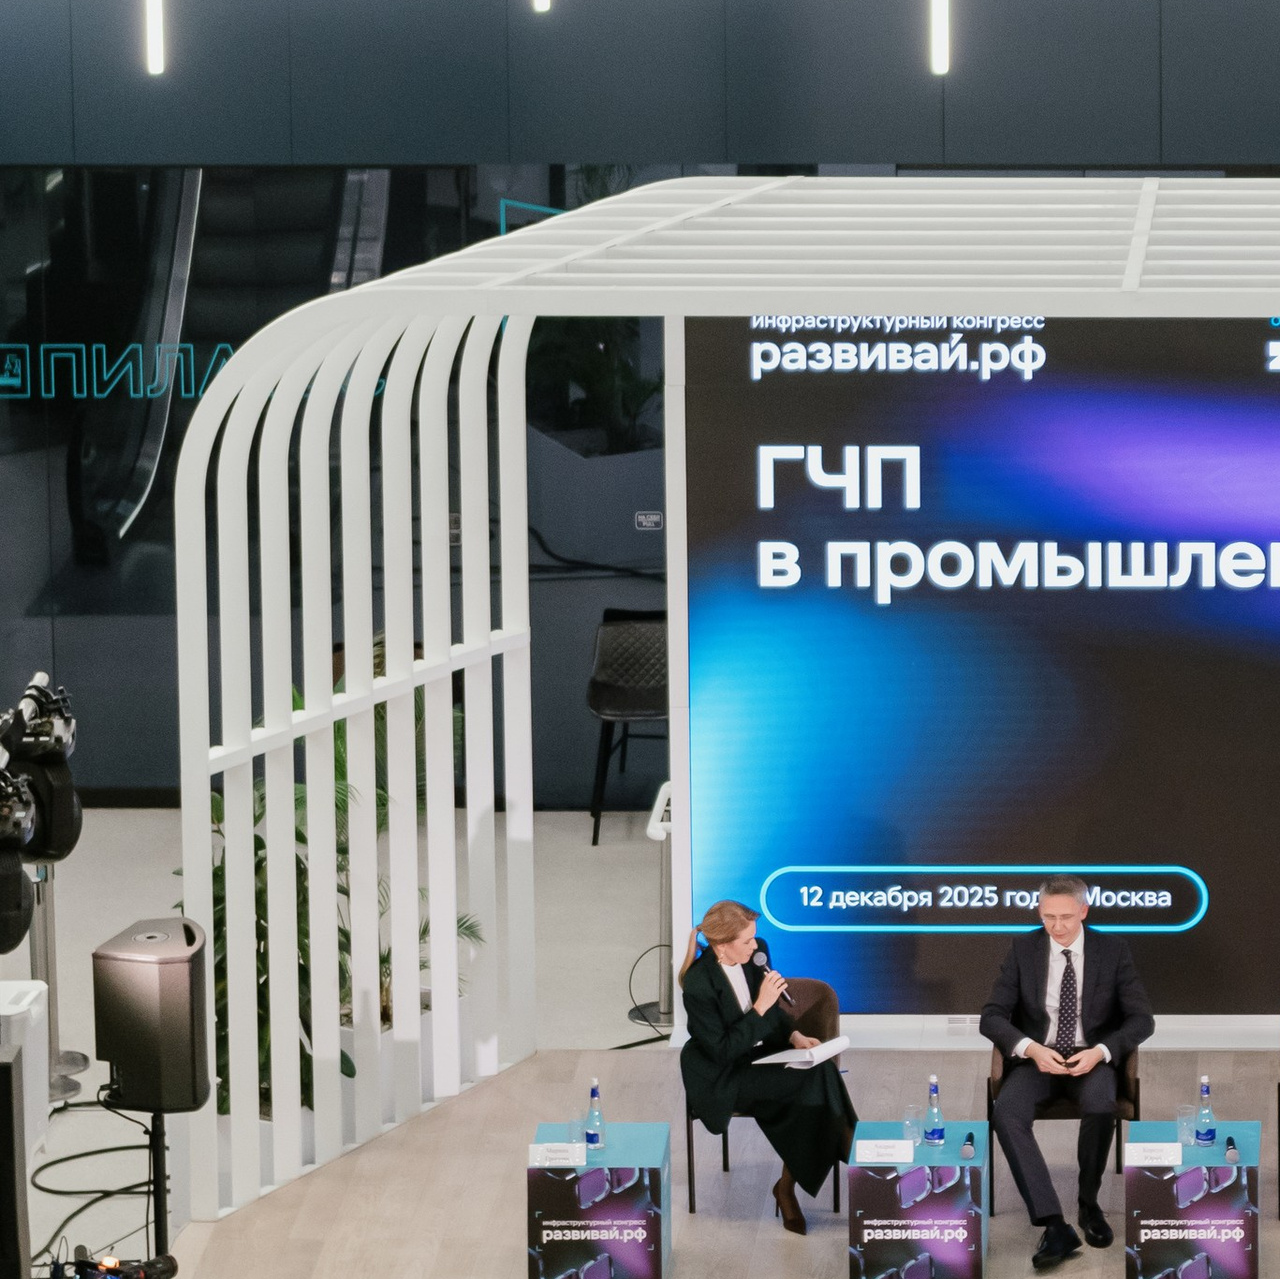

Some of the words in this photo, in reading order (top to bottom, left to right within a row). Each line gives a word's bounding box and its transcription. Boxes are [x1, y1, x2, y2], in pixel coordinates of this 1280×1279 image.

[752, 315, 948, 331] инфраструктурный
[952, 316, 1045, 330] конгресс
[751, 334, 1046, 379] развивай.рф
[758, 444, 921, 509] ГЧП
[758, 542, 801, 588] в
[800, 886, 823, 907] 12
[829, 885, 934, 912] декабря
[938, 886, 999, 907] 2025
[1005, 891, 1041, 910] год
[1084, 886, 1173, 907] Москва
[542, 1226, 647, 1243] развивай.рф
[863, 1226, 968, 1242] развивай.рф
[1140, 1226, 1245, 1242] развивай.рф
